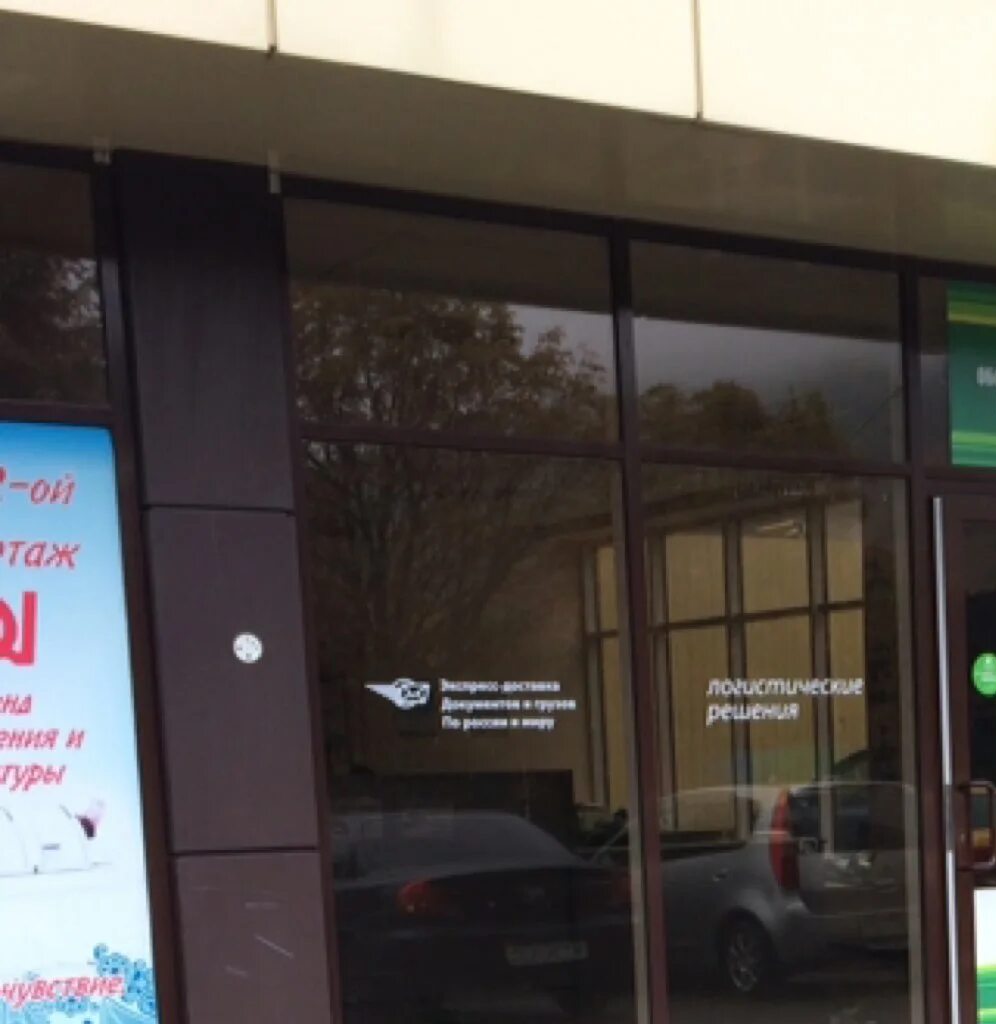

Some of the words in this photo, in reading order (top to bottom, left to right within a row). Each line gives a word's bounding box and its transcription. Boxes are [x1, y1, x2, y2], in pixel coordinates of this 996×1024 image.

[0, 540, 80, 570] таж
[706, 677, 864, 697] логистические
[706, 703, 800, 727] решения
